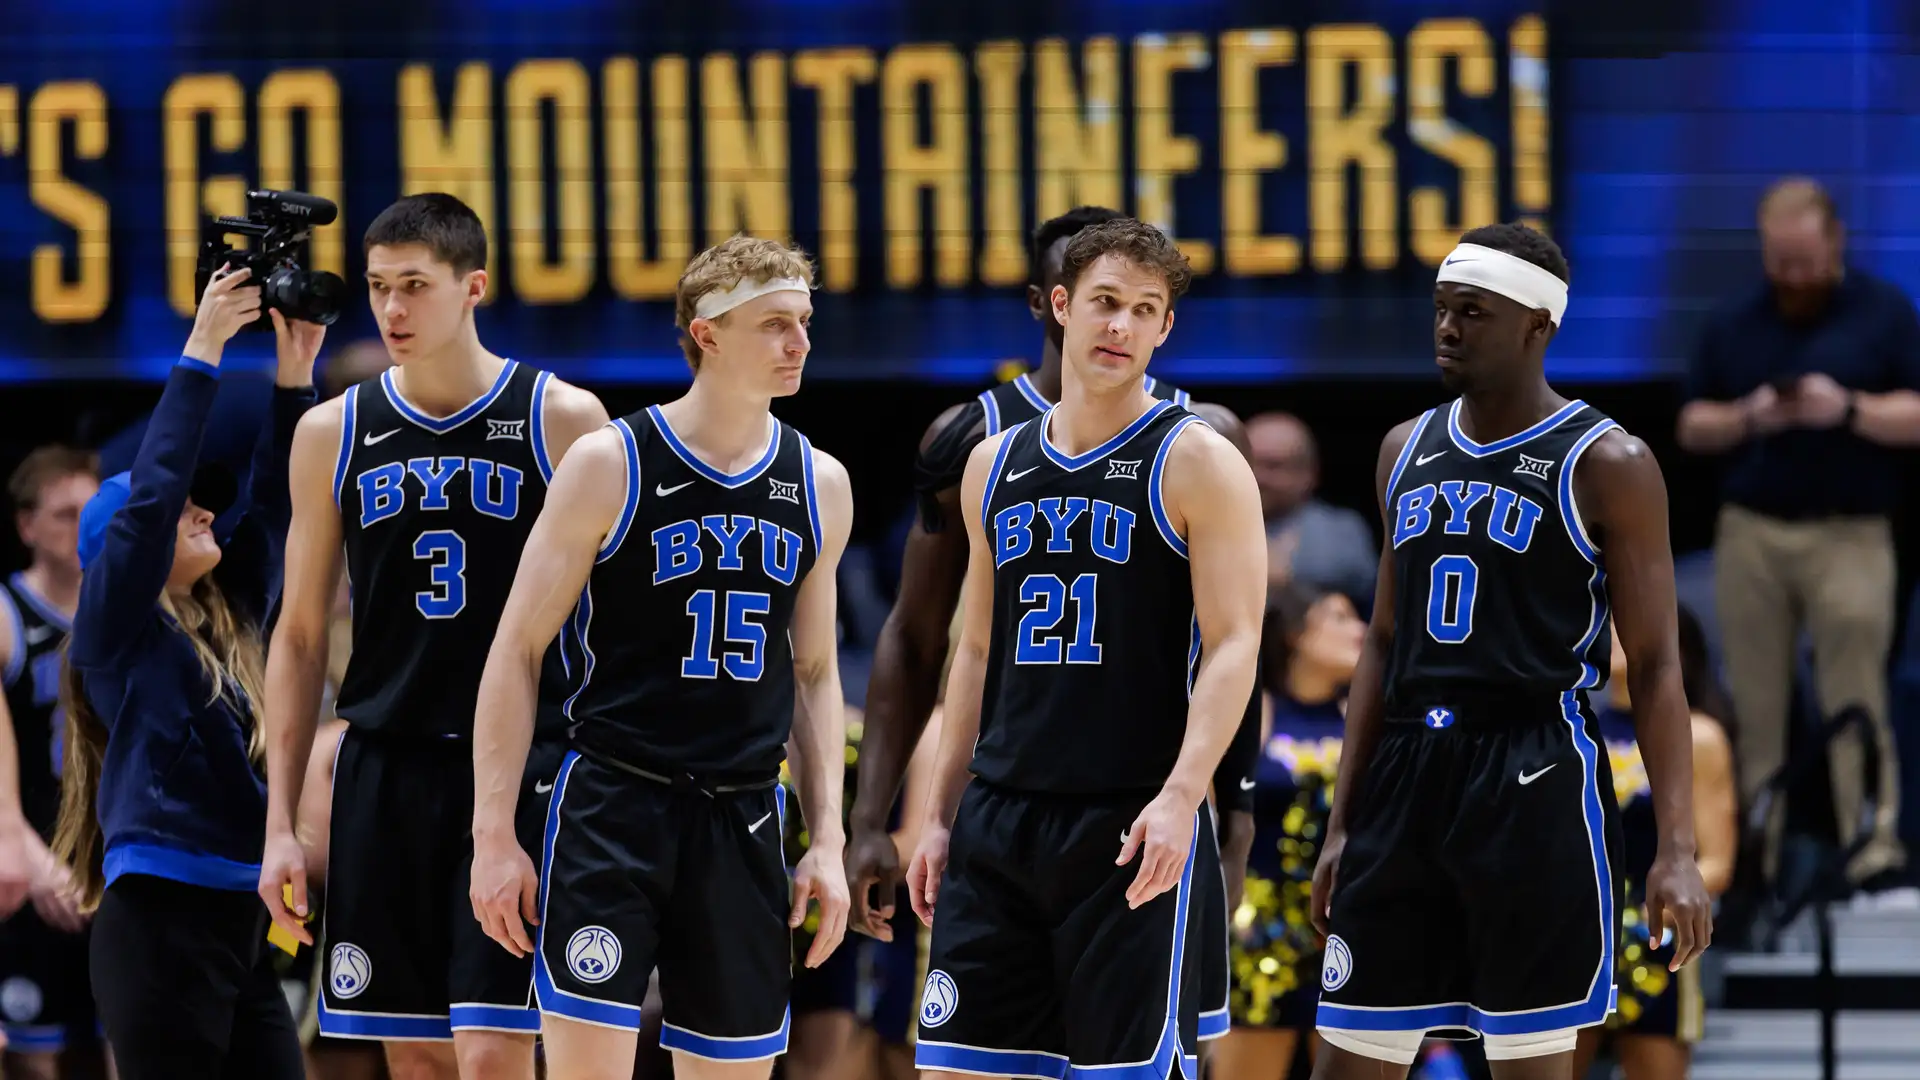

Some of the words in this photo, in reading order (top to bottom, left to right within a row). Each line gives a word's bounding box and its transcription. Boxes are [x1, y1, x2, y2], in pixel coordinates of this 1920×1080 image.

[163, 69, 345, 318] GO
[399, 14, 1550, 306] MOUNTAINEERS!
[281, 202, 312, 216] DEITY
[486, 419, 525, 441] XII
[357, 456, 523, 529] BYU
[768, 477, 800, 504] XII
[1104, 459, 1142, 480] XII
[1513, 453, 1555, 481] XII
[651, 514, 803, 586] BYU
[994, 497, 1136, 570] BYU
[1393, 480, 1543, 553] BYU
[412, 529, 466, 619] 3
[1426, 554, 1478, 644] 0
[681, 589, 770, 682] 15
[1015, 573, 1102, 665] 21
[1428, 709, 1450, 728] Y
